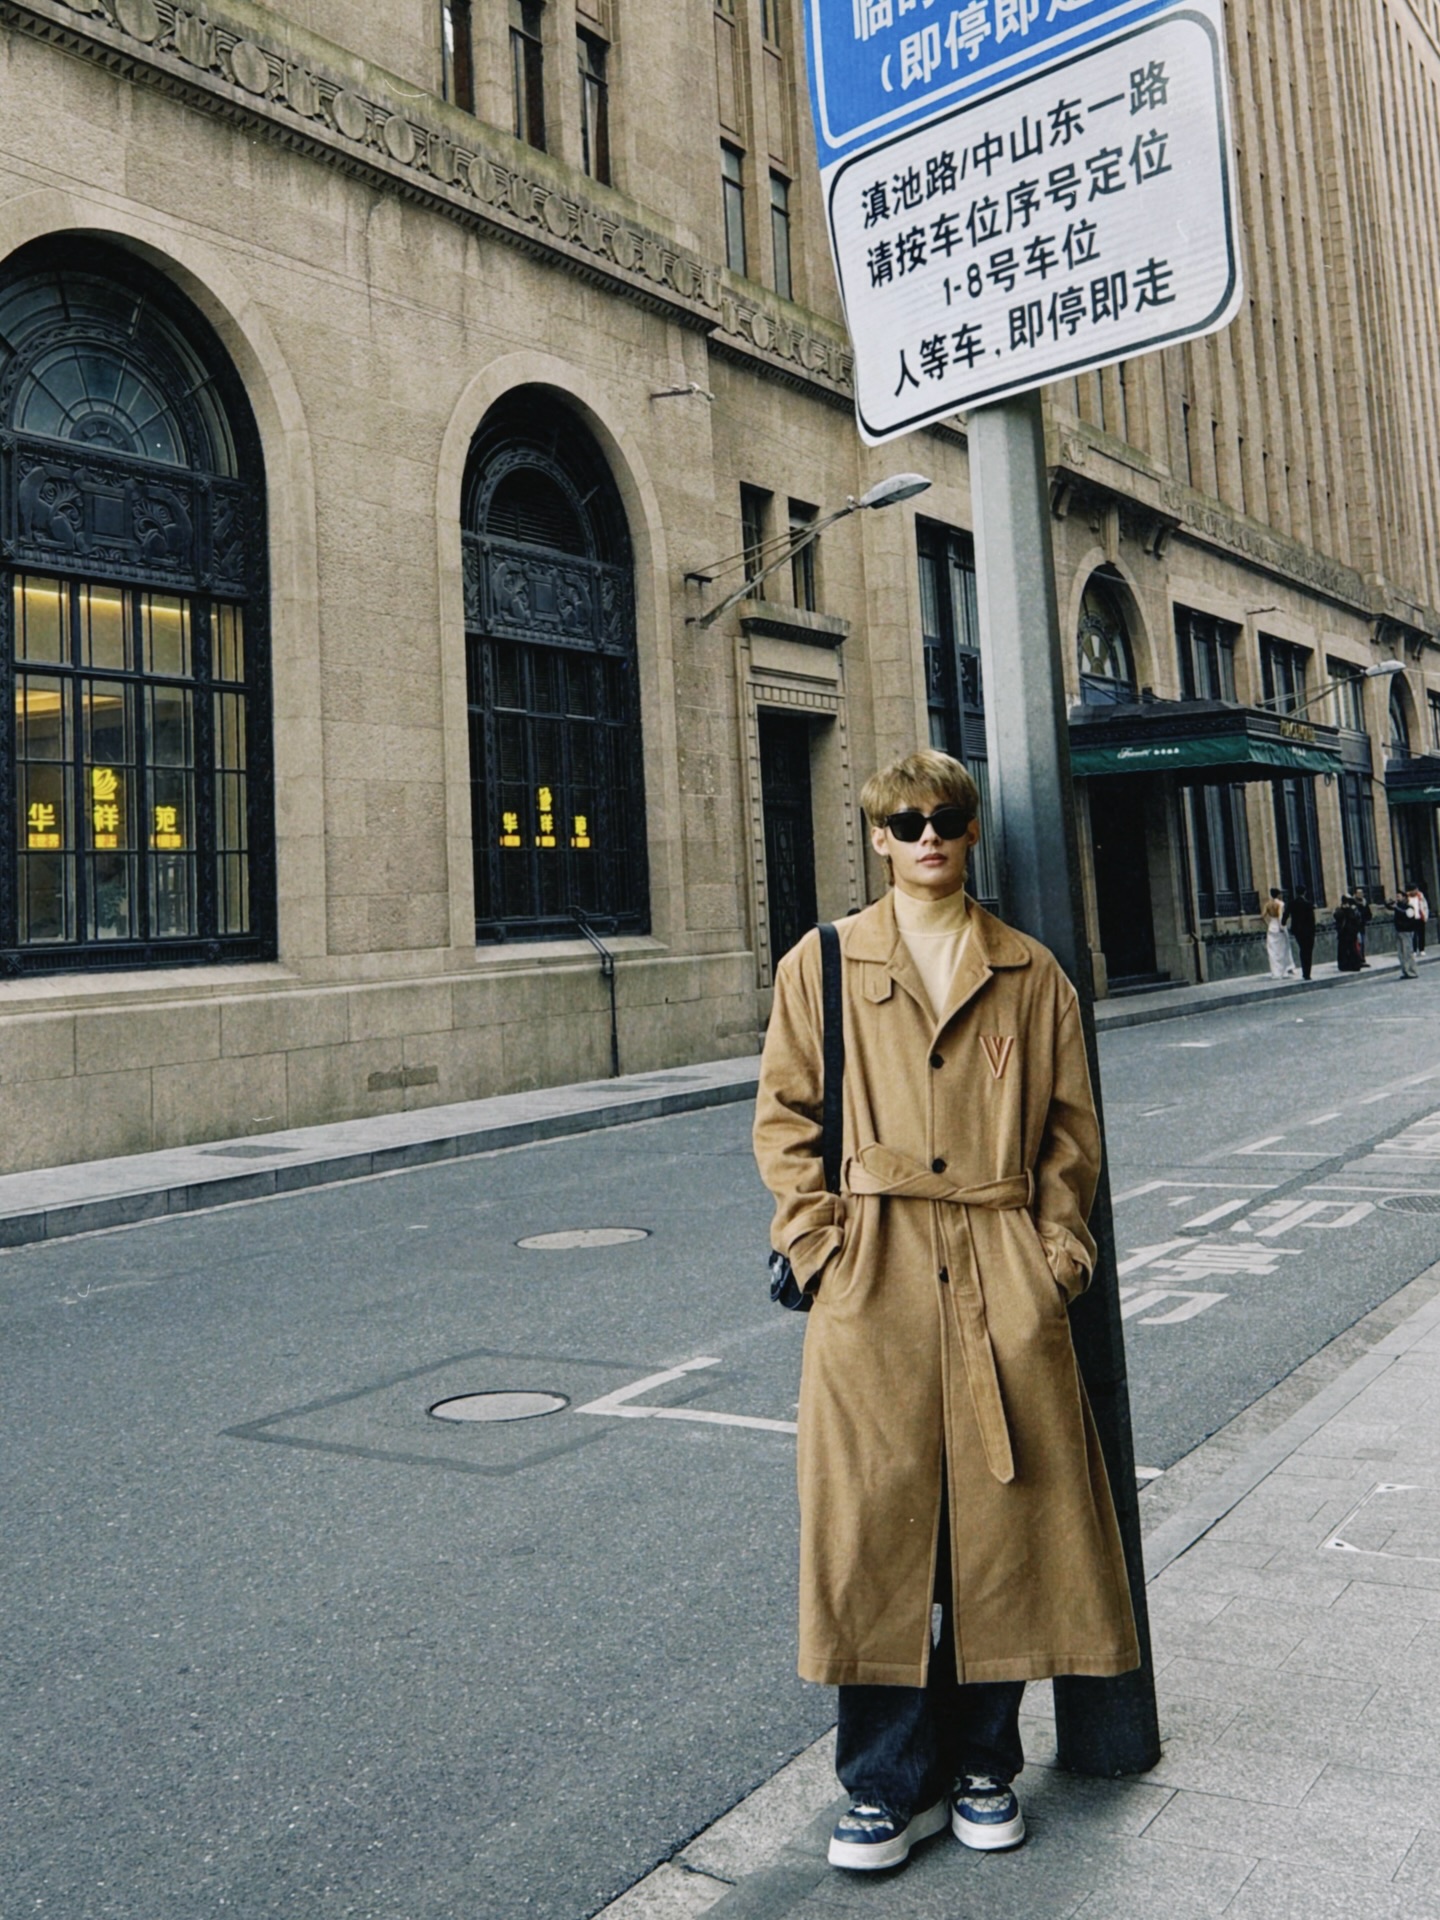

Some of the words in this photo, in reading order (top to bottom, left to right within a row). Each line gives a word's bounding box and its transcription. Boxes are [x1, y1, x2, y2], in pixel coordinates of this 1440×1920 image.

[881, 0, 1095, 92] （即停即
[862, 61, 1170, 229] 滇池路/中山东一路
[867, 127, 1173, 289] 请按车位序号定位
[943, 217, 1101, 306] 1-8号车位
